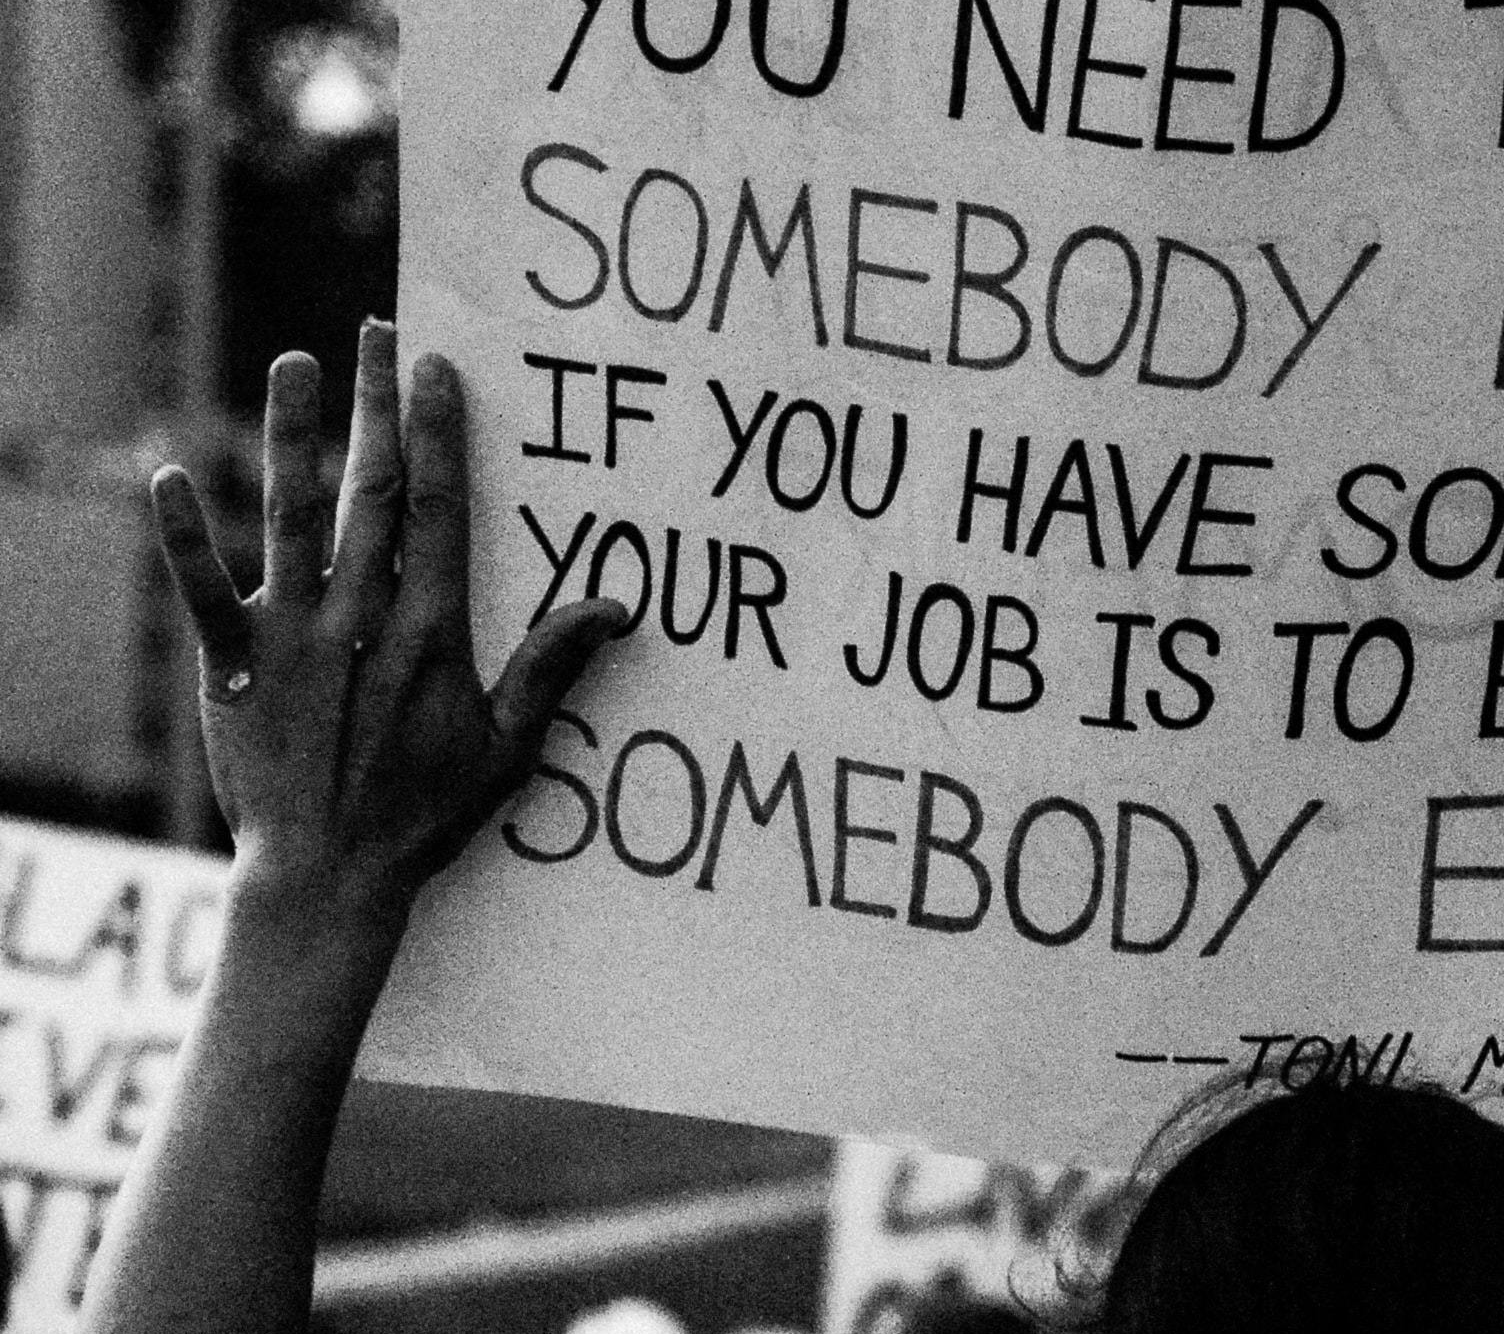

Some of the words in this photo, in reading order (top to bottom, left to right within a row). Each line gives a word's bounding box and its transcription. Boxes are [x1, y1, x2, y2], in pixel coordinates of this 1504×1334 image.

[521, 143, 1381, 398] SOMEBODY
[522, 352, 668, 469] IF
[706, 378, 909, 520] YOU
[956, 428, 1274, 578] HAVE
[518, 504, 788, 669] YOUR
[843, 571, 1045, 714] JOB
[1080, 612, 1222, 732] IS
[1273, 615, 1416, 744] TO
[500, 707, 1326, 958] SOMEBODY
